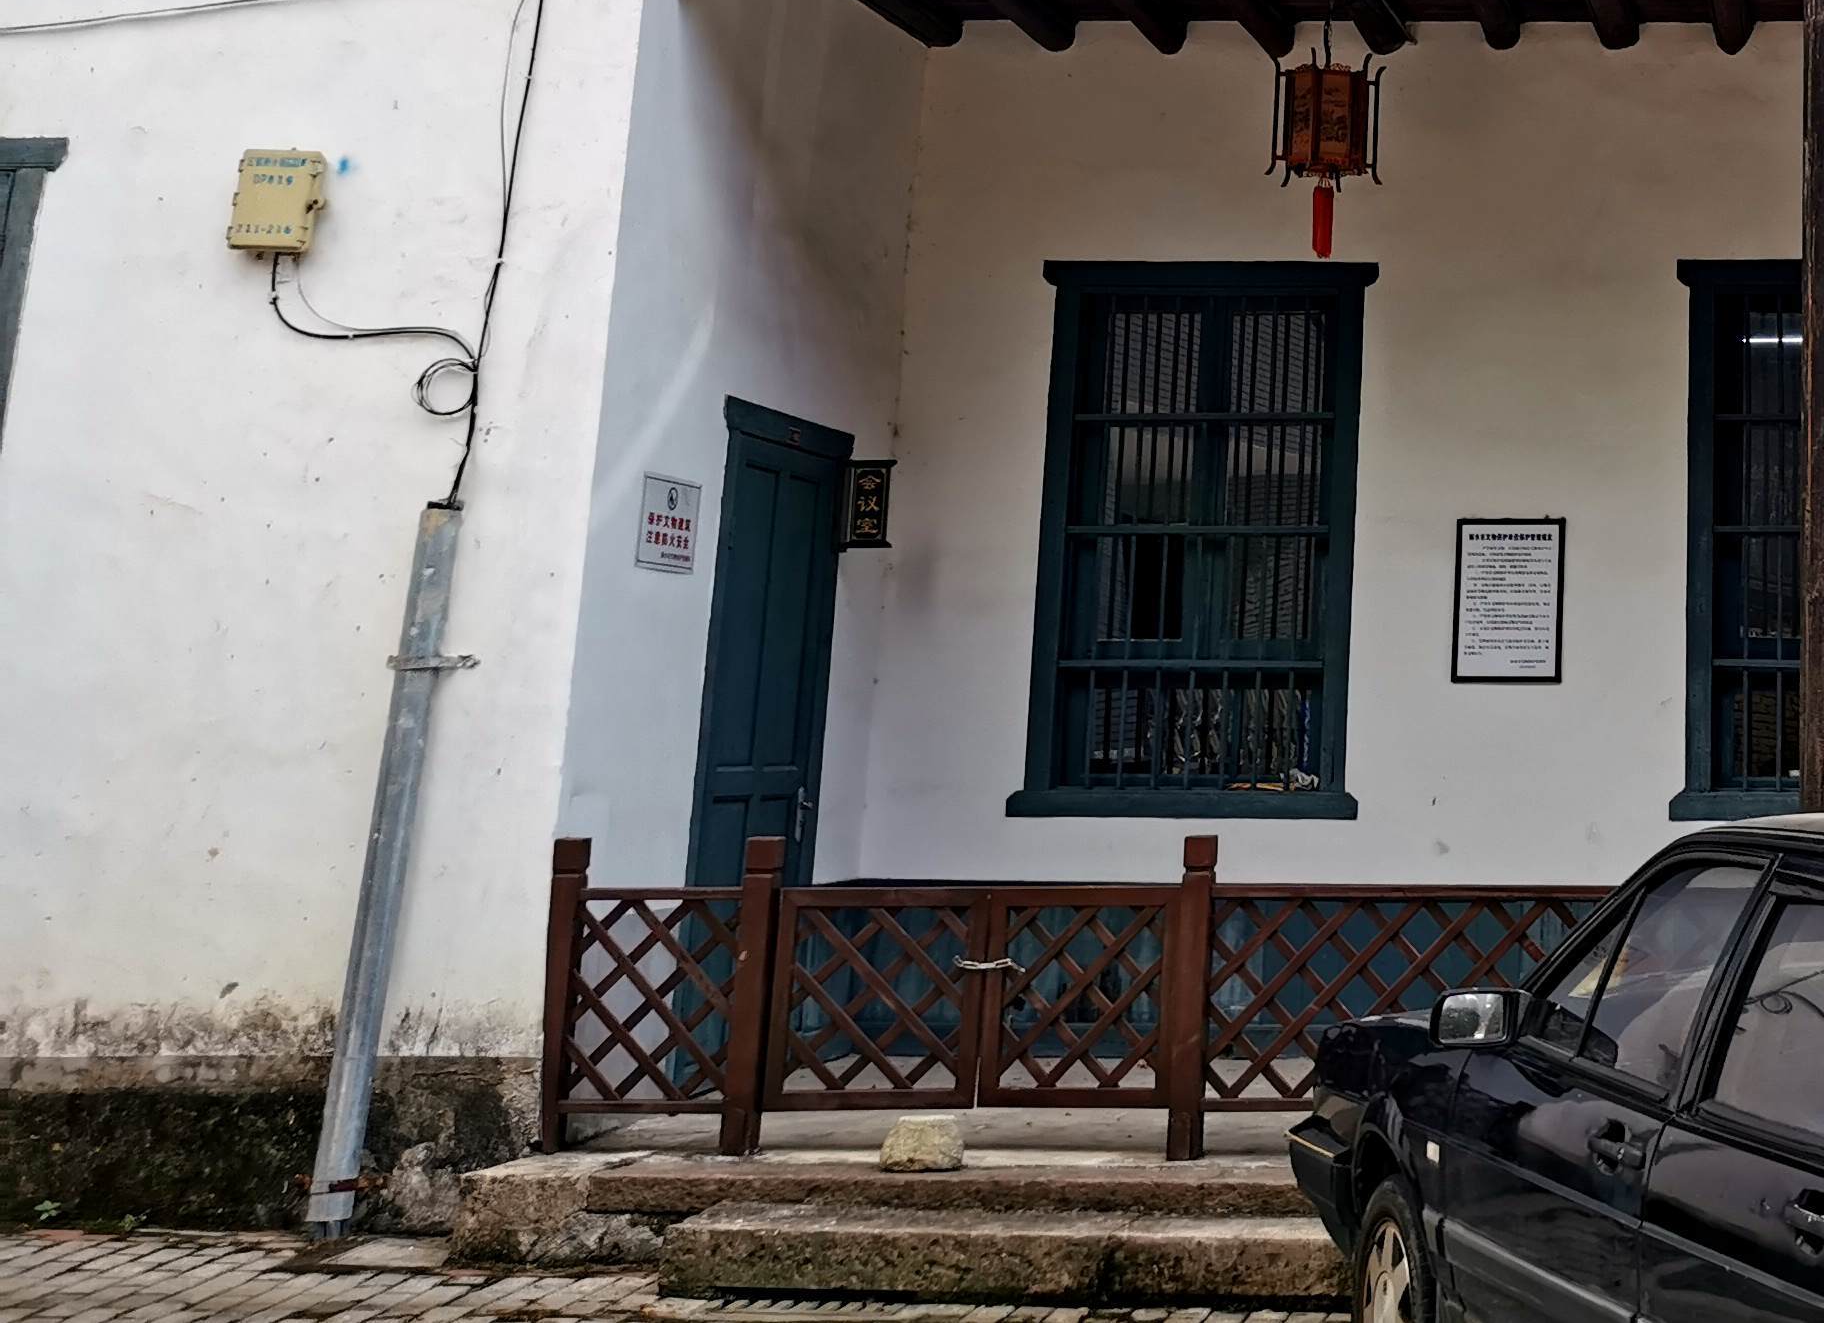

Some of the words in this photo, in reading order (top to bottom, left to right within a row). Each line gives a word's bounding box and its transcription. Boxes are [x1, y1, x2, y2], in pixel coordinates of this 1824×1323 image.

[855, 474, 881, 535] 会议室
[647, 511, 692, 533] 保护文物建筑
[645, 530, 690, 550] 注意防火安全
